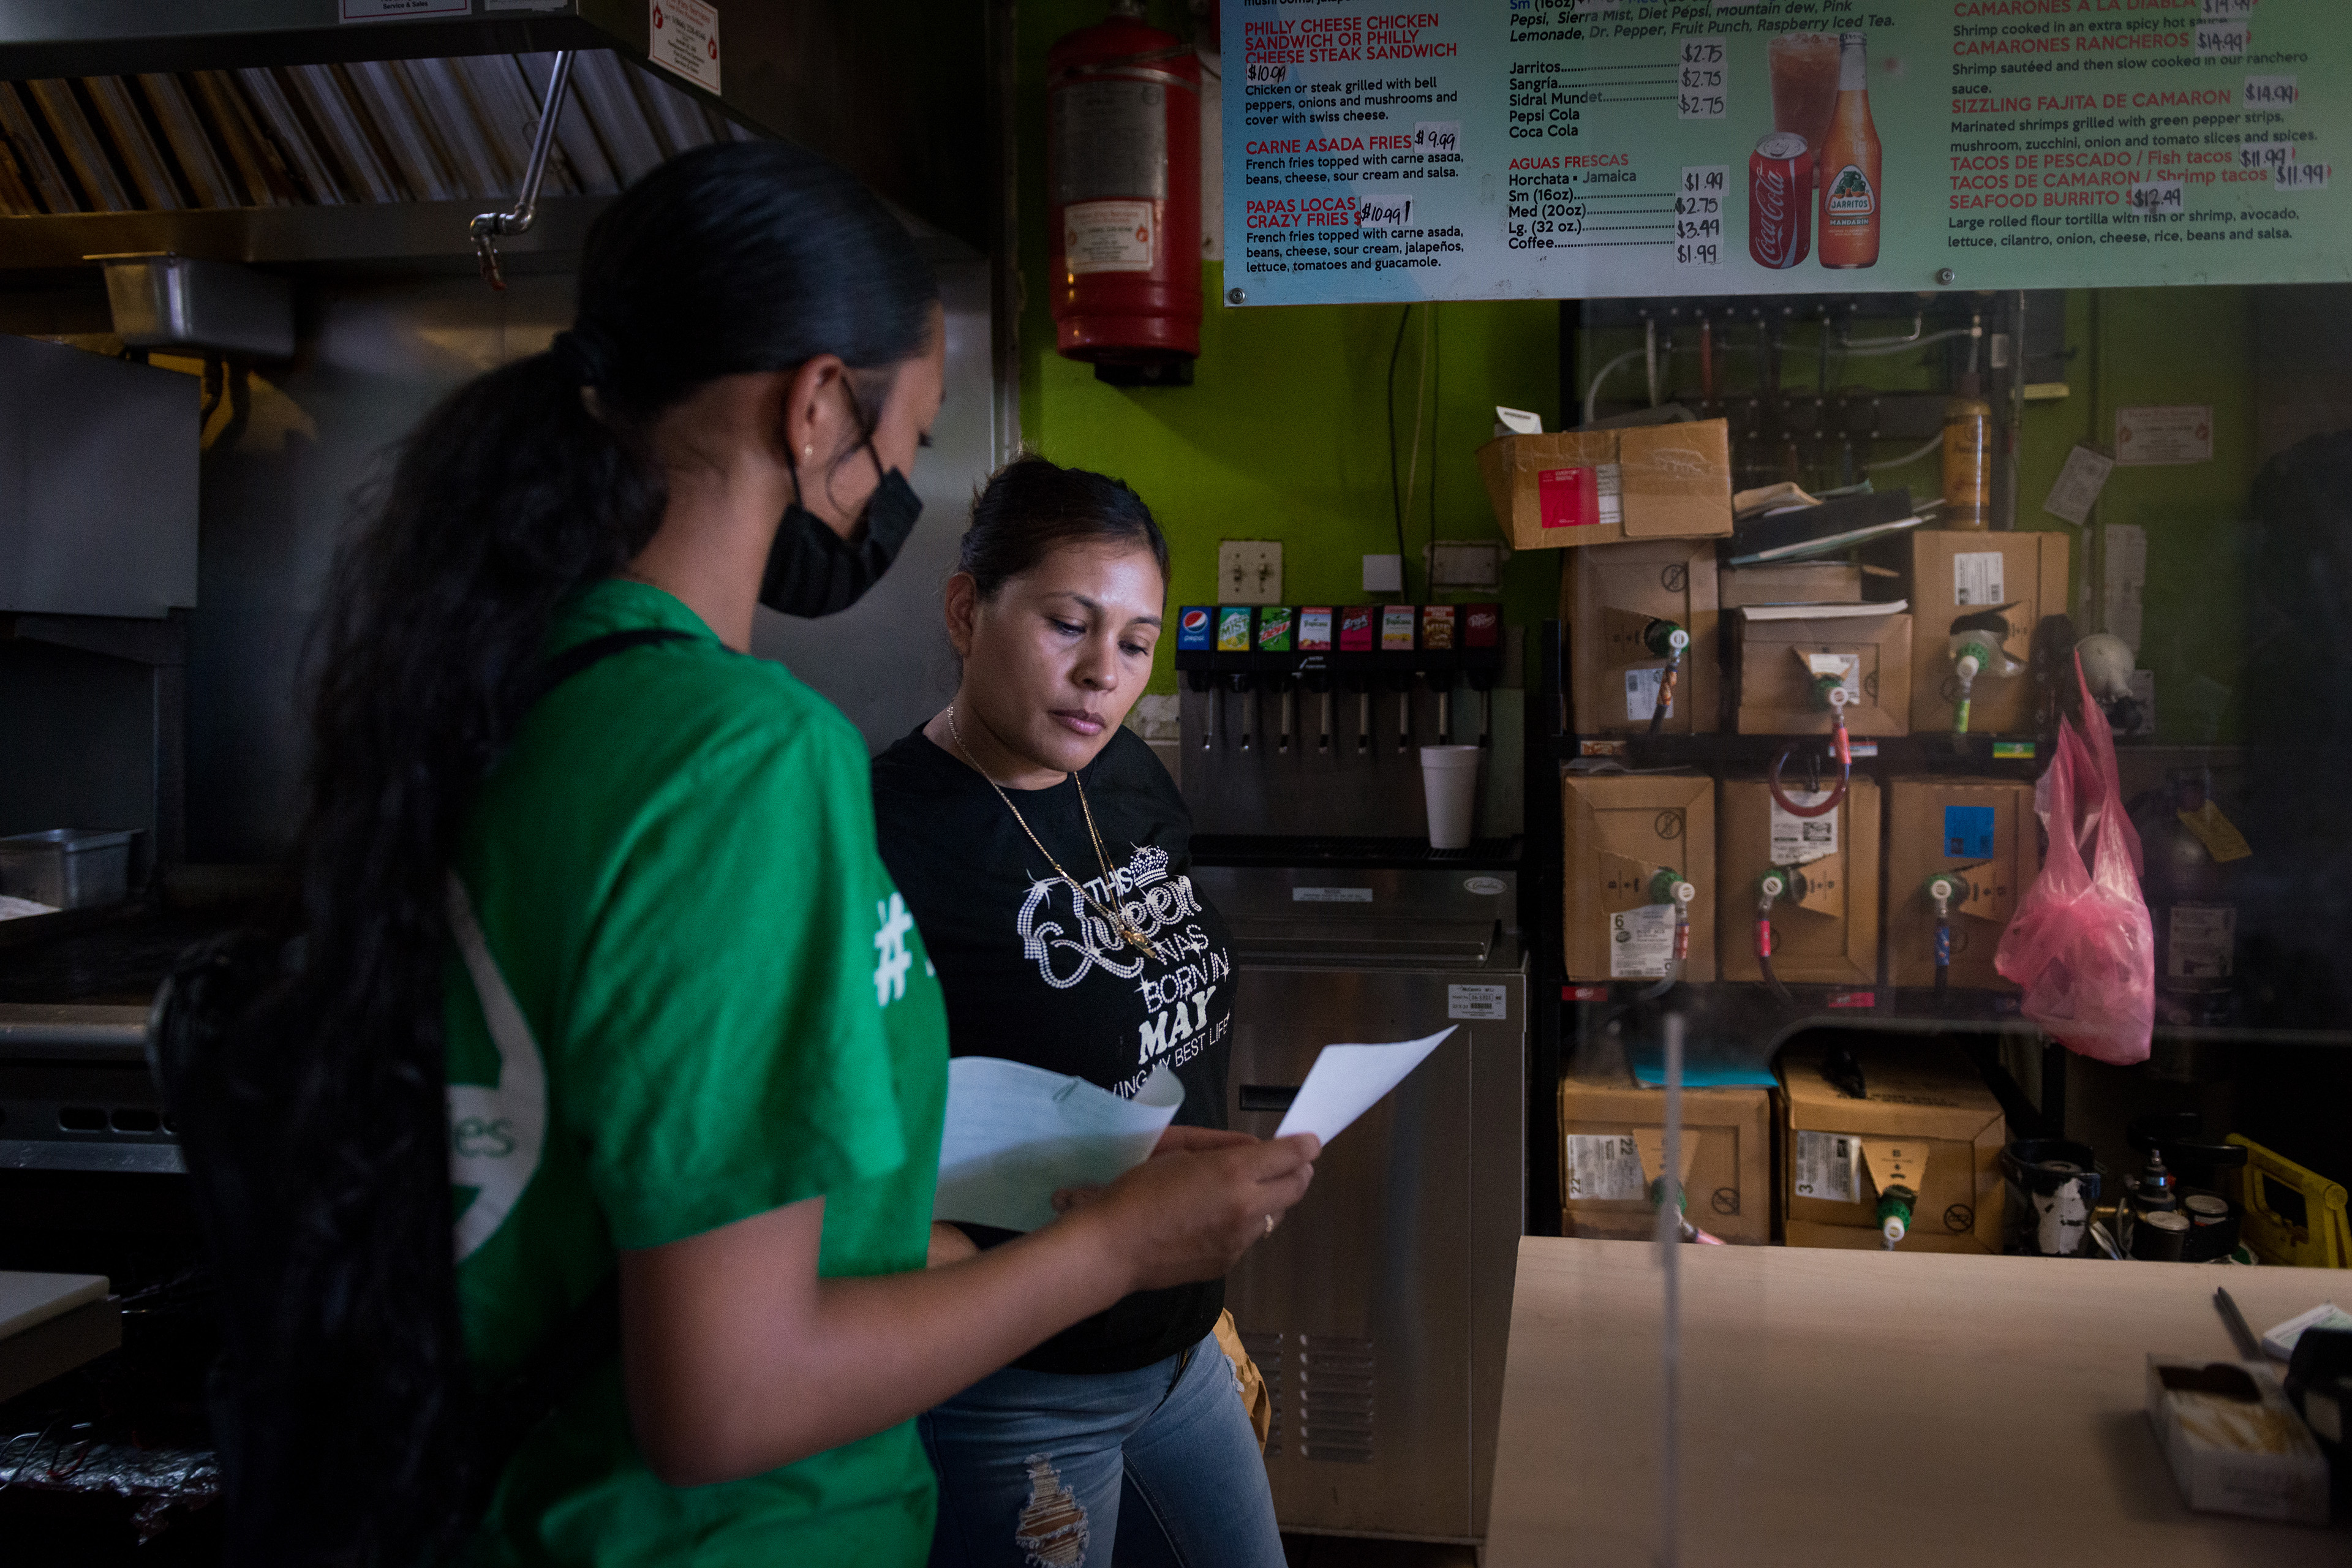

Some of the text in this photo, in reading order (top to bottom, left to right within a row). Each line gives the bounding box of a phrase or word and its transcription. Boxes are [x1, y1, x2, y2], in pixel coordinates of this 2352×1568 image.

[1510, 12, 1548, 28] Pepsi,
[1558, 11, 1598, 24] Sierra
[1603, 9, 1633, 21] Mist,
[1638, 7, 1668, 20] Diet
[1672, 4, 1713, 24] Pepsi,
[1717, 1, 1780, 16] Mountain
[1785, 1, 1817, 13] dew,
[1823, 1, 1852, 12] Pink
[1954, 0, 2071, 17] CAMARONES
[2097, 0, 2120, 11] LA
[1245, 13, 1438, 36] PHILLY CHEESE CHICKEN
[1510, 15, 1894, 42] Lemonade, Dr. Pepper, Fruit Punch, Raspberry Iced Tea.
[1245, 29, 1419, 51] SANDWICH OR PHILLY
[1954, 32, 2189, 55] CAMARONES RANCHEROS
[2198, 32, 2242, 51] $14.99
[1246, 43, 1457, 63] CHEESE STEAK SANDWICH
[1682, 43, 1722, 63] $2.75
[1248, 64, 1286, 82] $10.99
[1682, 68, 1722, 88] $2.75
[1245, 84, 1291, 96] Chicken
[1311, 81, 1341, 92] steak
[1346, 79, 1382, 94] grilled
[1386, 78, 1411, 89] with
[1415, 77, 1437, 88] bell
[2246, 84, 2293, 103] $14.99
[1246, 91, 1457, 113] peppers, onions and mushrooms and
[1510, 92, 1547, 106] Sidral
[1678, 94, 1724, 114] $2.75
[1952, 90, 2230, 113] SIZZLING FAJITA DE CAMARON
[1246, 110, 1388, 126] cover with swiss cheese.
[1510, 108, 1580, 125] Pepsi Cola
[1415, 130, 1455, 151] $9.99
[1509, 124, 1578, 138] Coca Cola
[1246, 135, 1412, 154] CARNE ASADA FRIES
[1246, 153, 1463, 170] French fries topped with carne asada,
[1509, 154, 1628, 170] AGUAS FRESCAS
[1950, 150, 2232, 170] TACOS DE PESCADO Fish tacos
[1509, 170, 1636, 186] Horchata Jamaica
[1684, 172, 1723, 191] $1.99
[1950, 168, 2267, 190] TACOS DE CAMARON Shrimp tacos
[1247, 197, 1355, 213] PAPAS LOCAS
[1509, 187, 1573, 206] Sm (16oz)
[1675, 197, 1718, 215] $2.75
[1831, 200, 1868, 209] JARRITOS
[1950, 190, 2119, 209] SEAFOOD BURRITO
[1247, 212, 1348, 228] CRAZY FRIES
[1509, 203, 1586, 220] Med (20oz)
[1509, 219, 1581, 238] Lg. (32 oz.)
[1948, 227, 2292, 247] lettuce, cilantro, onion, cheese, rice, beans and salsa.
[1247, 241, 1463, 258] beans, cheese, sour cream, jalapeños,
[1677, 244, 1717, 263] $1.99
[1247, 256, 1441, 273] lettuce, tomatoes and guacamole.
[1082, 867, 1133, 904] THIS
[1615, 914, 1624, 928] 6
[1138, 948, 1232, 1014] BORN IN
[1139, 985, 1216, 1065] MAY
[1175, 1033, 1205, 1067] BEST
[1210, 1008, 1231, 1046] LIFE
